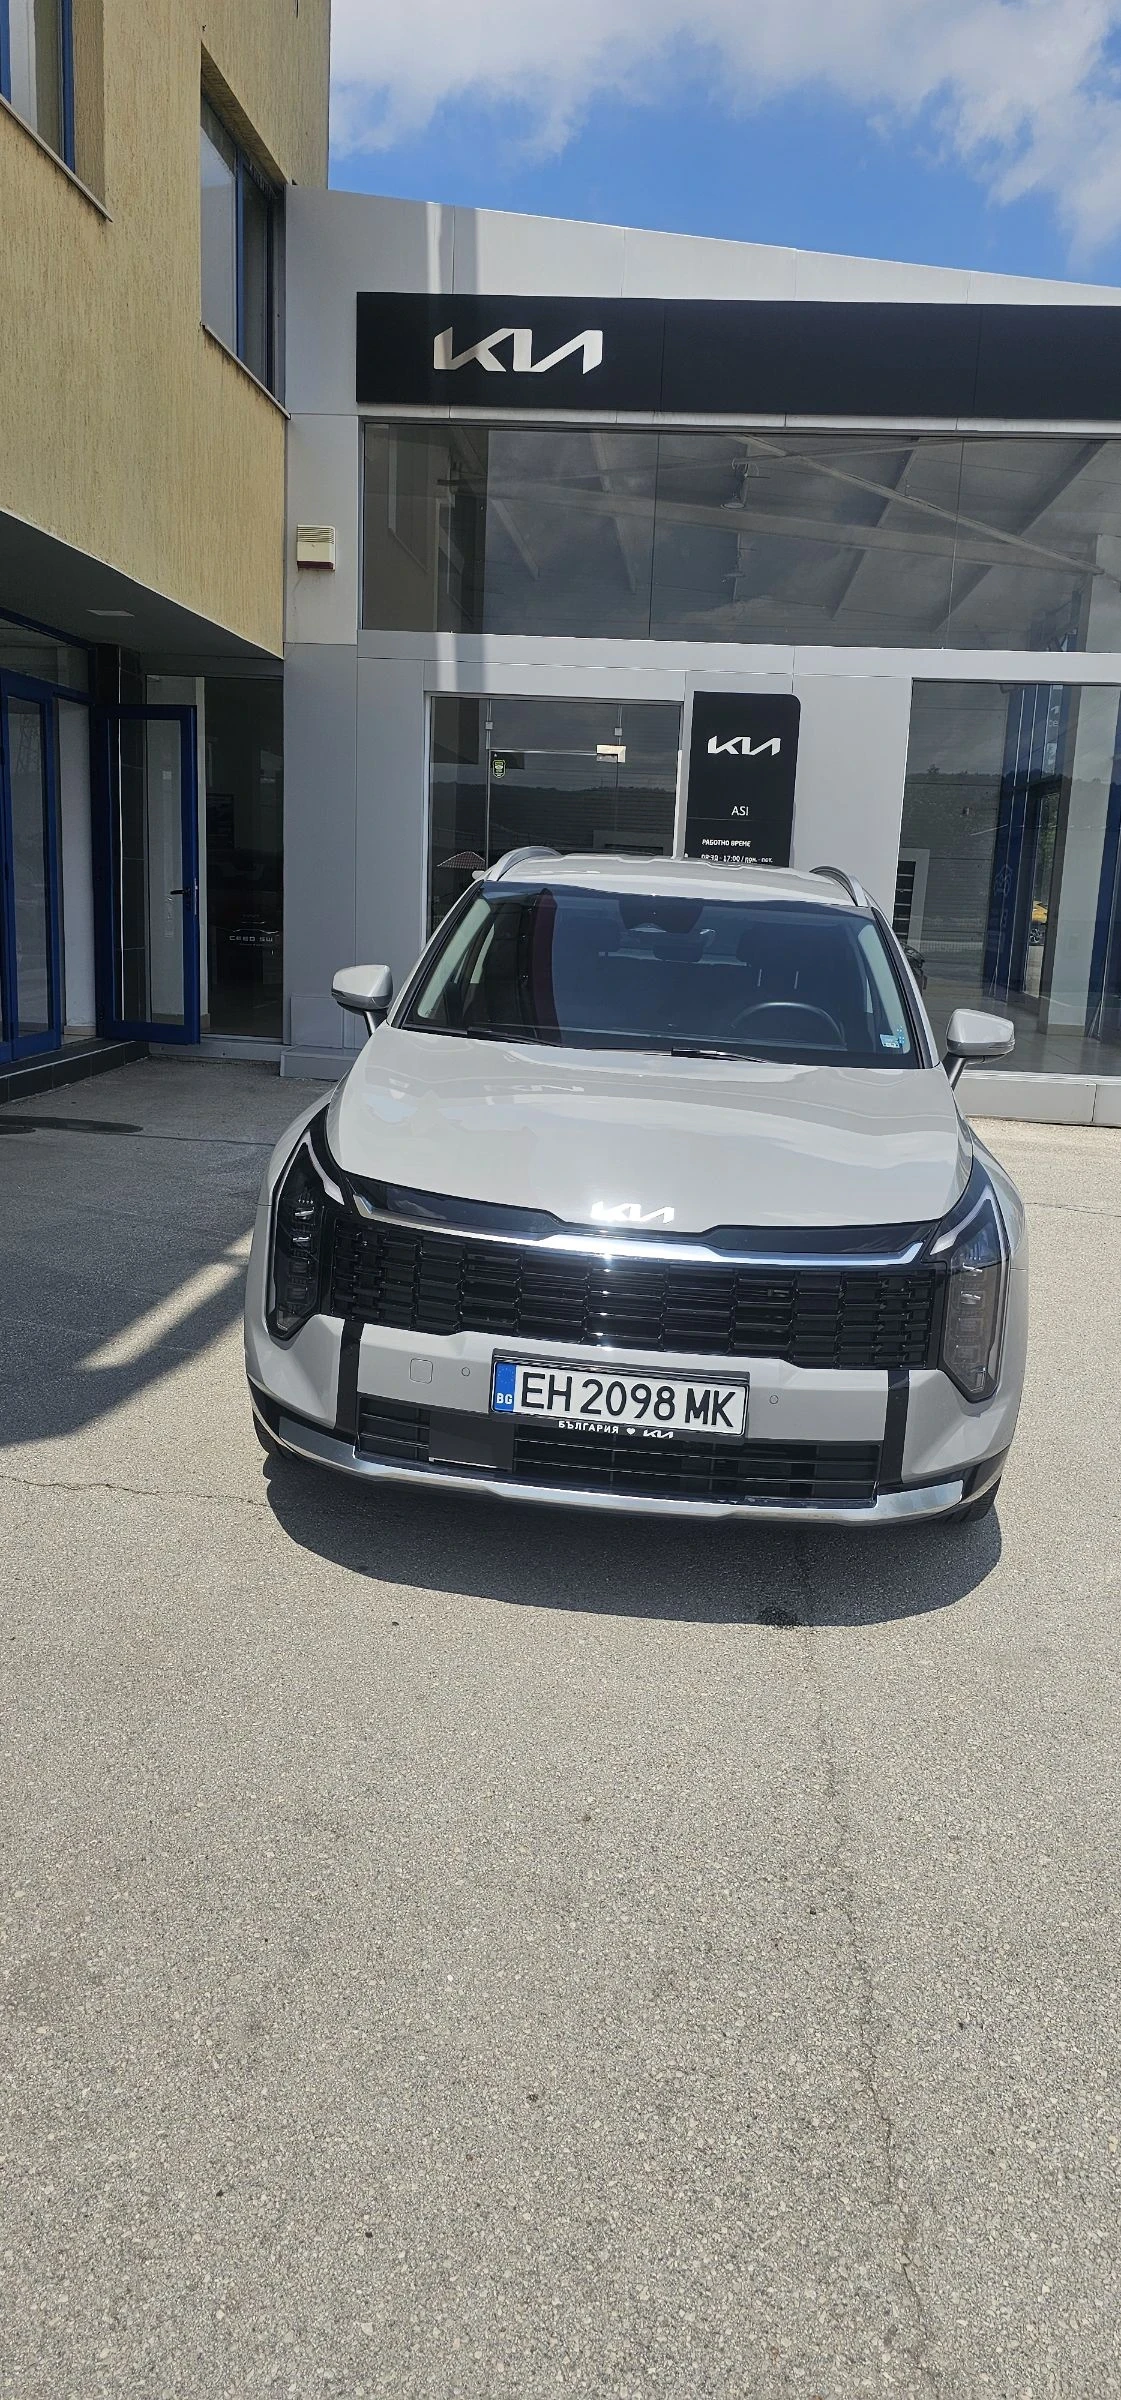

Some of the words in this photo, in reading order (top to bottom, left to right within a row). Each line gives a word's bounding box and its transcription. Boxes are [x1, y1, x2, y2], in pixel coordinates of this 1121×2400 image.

[433, 326, 603, 374] KIA
[707, 735, 782, 756] KIA
[731, 805, 749, 816] ASI
[730, 840, 751, 848] ВРЕМЕ
[723, 855, 741, 863] 17:00
[591, 1201, 675, 1224] KIA
[496, 1392, 513, 1405] BG
[520, 1371, 573, 1412] EH
[580, 1378, 676, 1421] 2098
[684, 1387, 737, 1428] MK
[558, 1420, 620, 1435] БЪЛГАРИЯ
[643, 1428, 674, 1439] KIA
